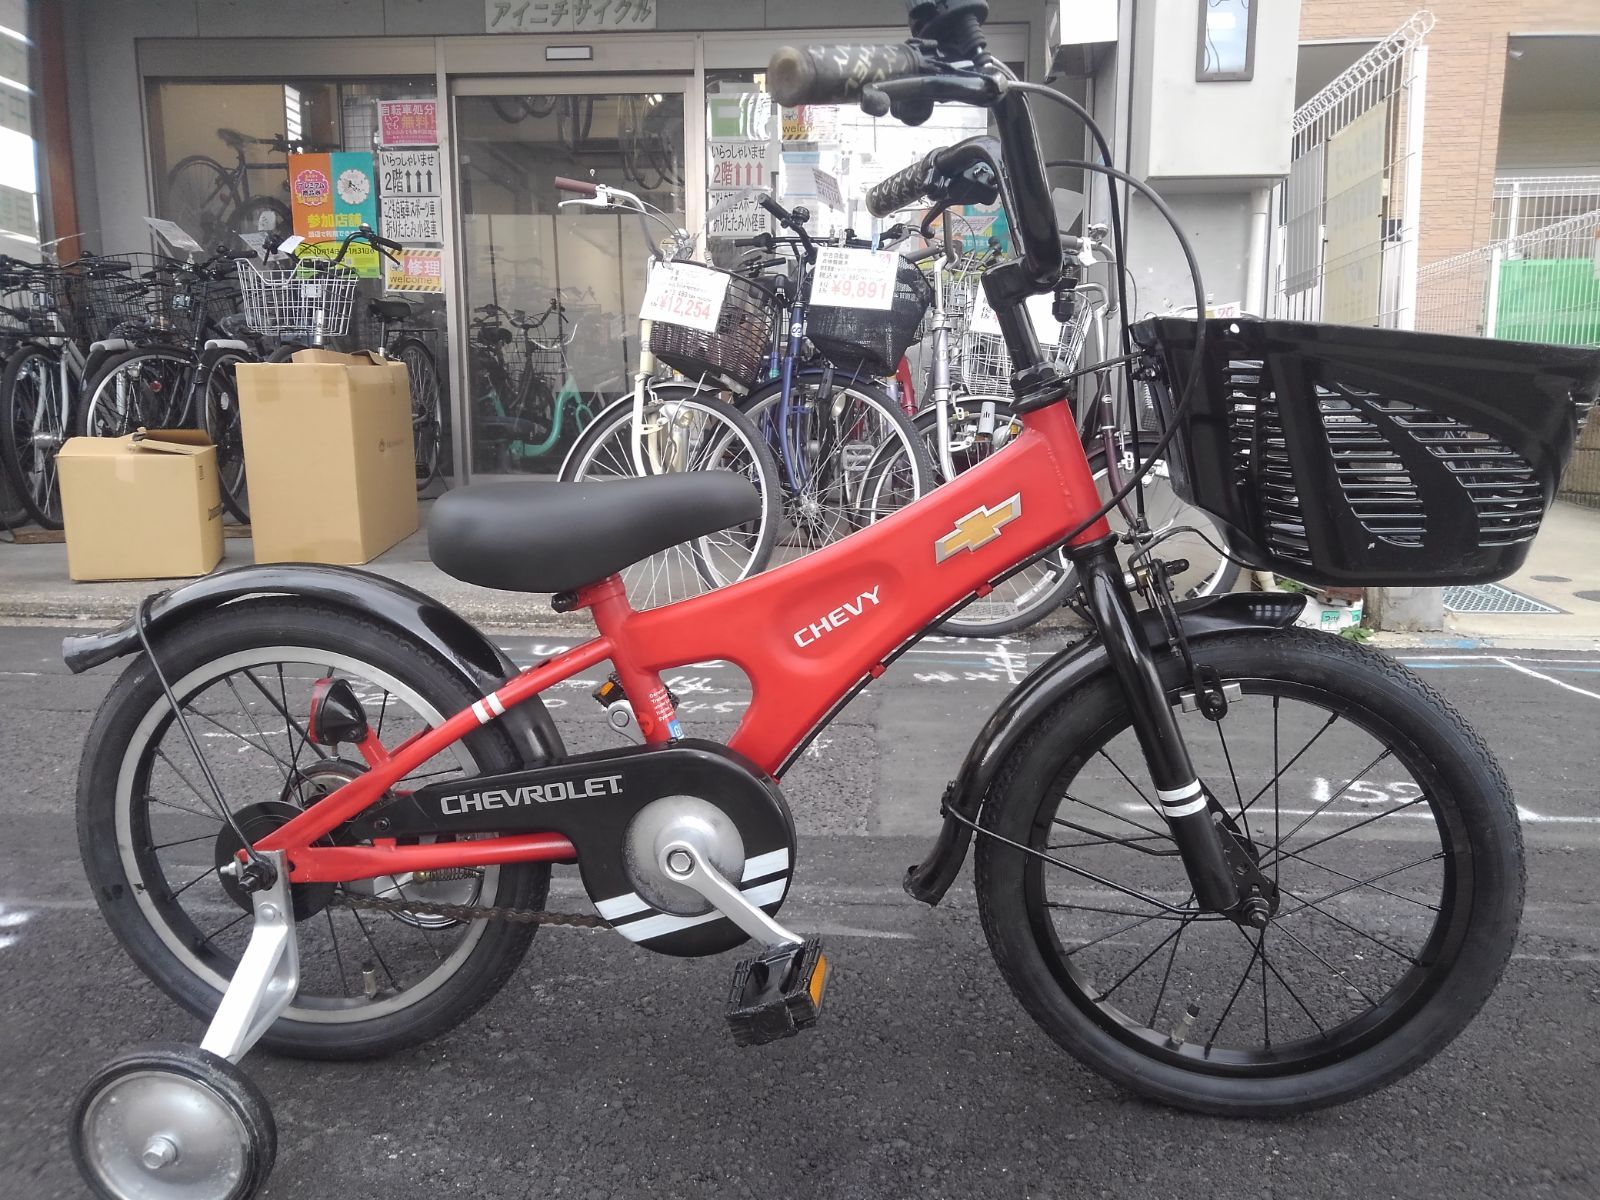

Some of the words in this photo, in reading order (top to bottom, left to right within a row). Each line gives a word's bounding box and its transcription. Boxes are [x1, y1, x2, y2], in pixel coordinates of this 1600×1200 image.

[491, 0, 652, 28] アイニチサイクル
[782, 123, 817, 133] welco
[382, 152, 435, 167] いらっしゃいませ
[711, 144, 766, 160] いらっしゃいませ
[384, 168, 404, 194] 2階
[713, 160, 734, 186] 2階
[384, 199, 437, 219] こども自転車スポーツ車
[307, 213, 362, 228] 参加店舗
[385, 219, 438, 239] 折りたたみ小径車
[406, 258, 441, 276] 修理
[389, 275, 433, 285] welcome
[659, 294, 711, 320] ¥12,254
[793, 584, 880, 648] CHEVY
